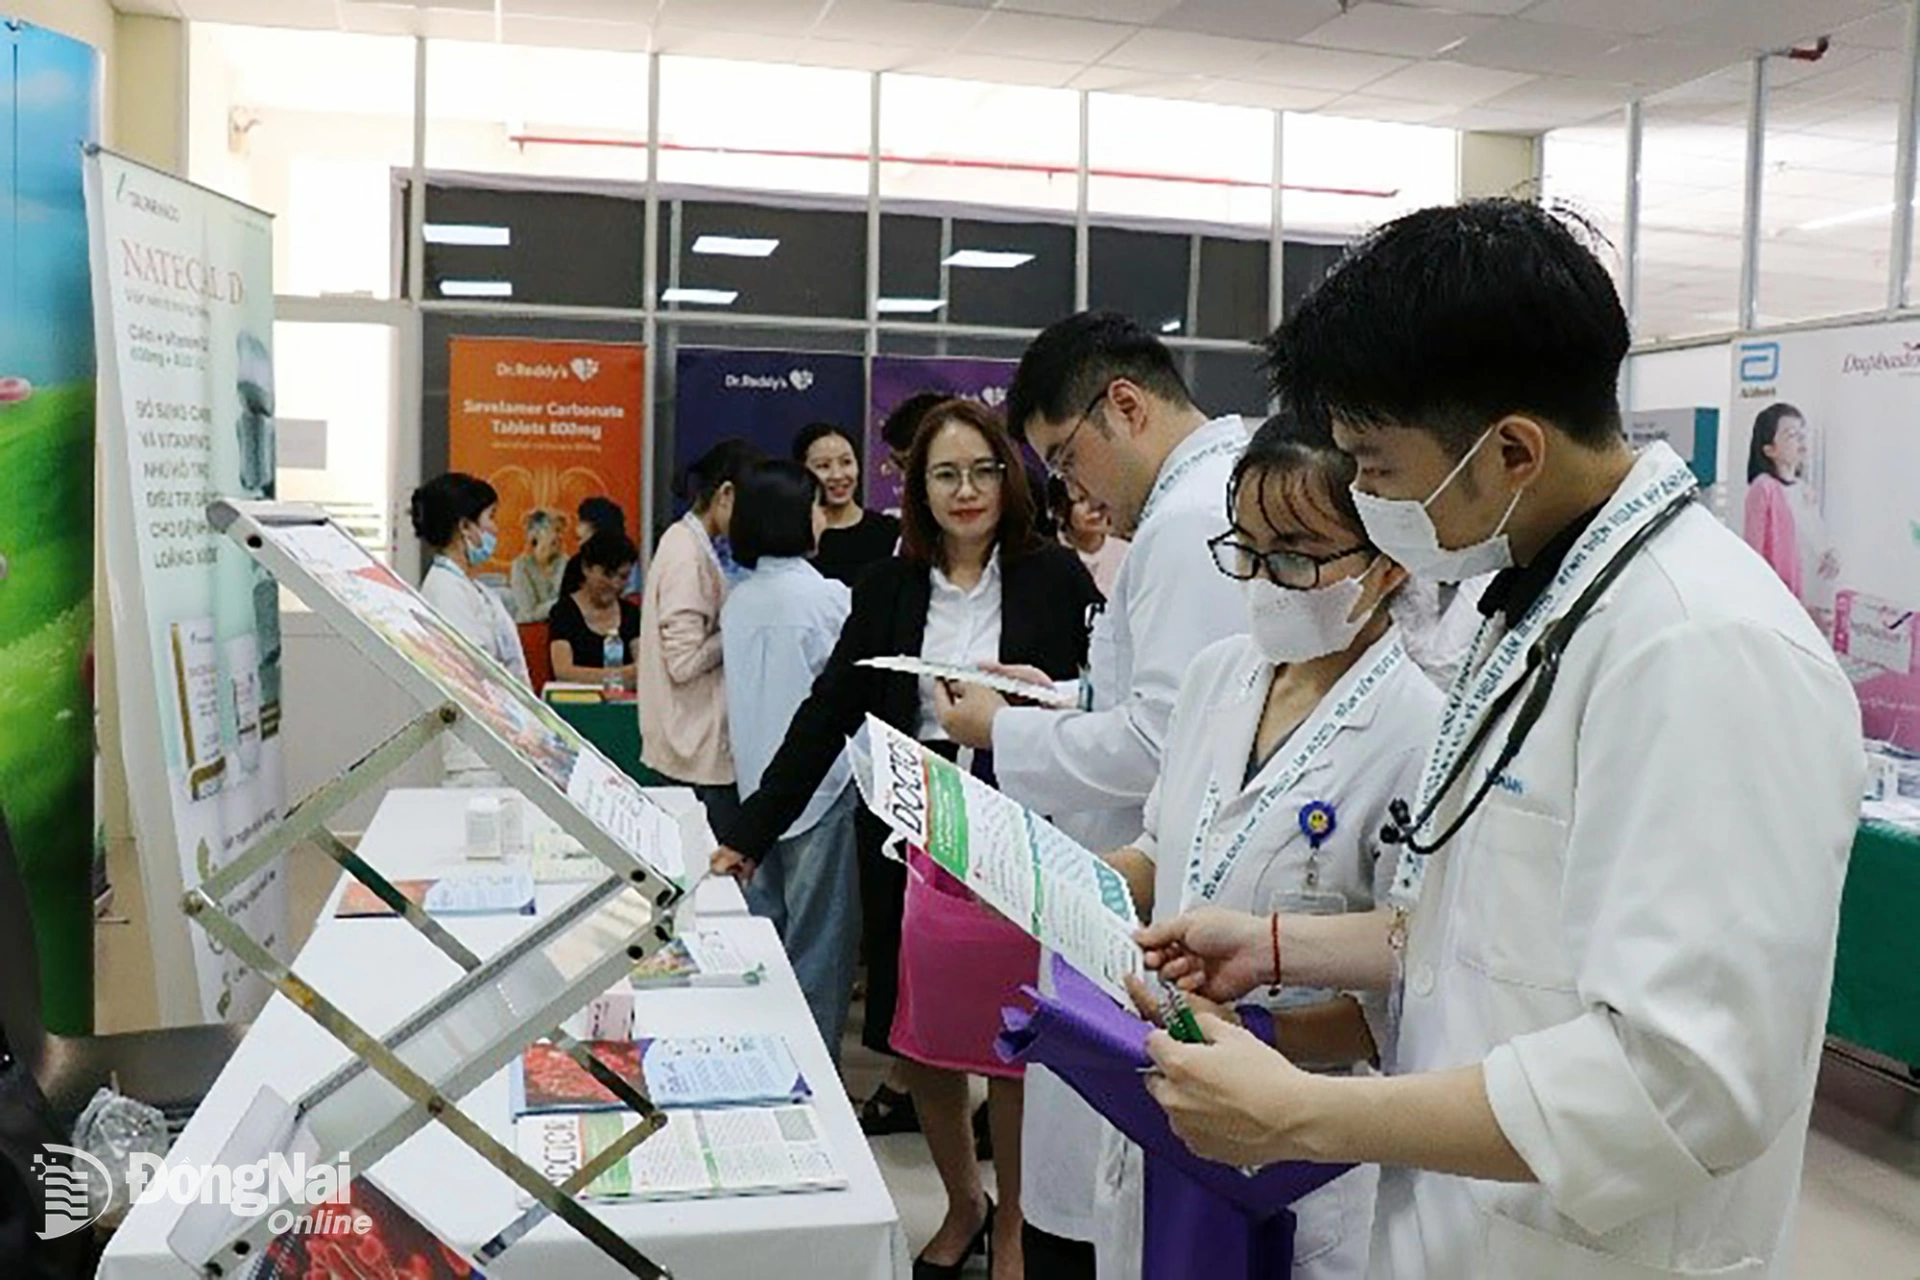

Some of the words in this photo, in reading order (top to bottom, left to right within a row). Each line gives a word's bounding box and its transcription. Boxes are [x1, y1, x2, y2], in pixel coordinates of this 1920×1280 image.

[120, 237, 225, 302] NATECAL
[496, 361, 569, 380] Dr.Reddy's
[546, 400, 625, 418] Carbonate
[491, 420, 546, 436] Tablets
